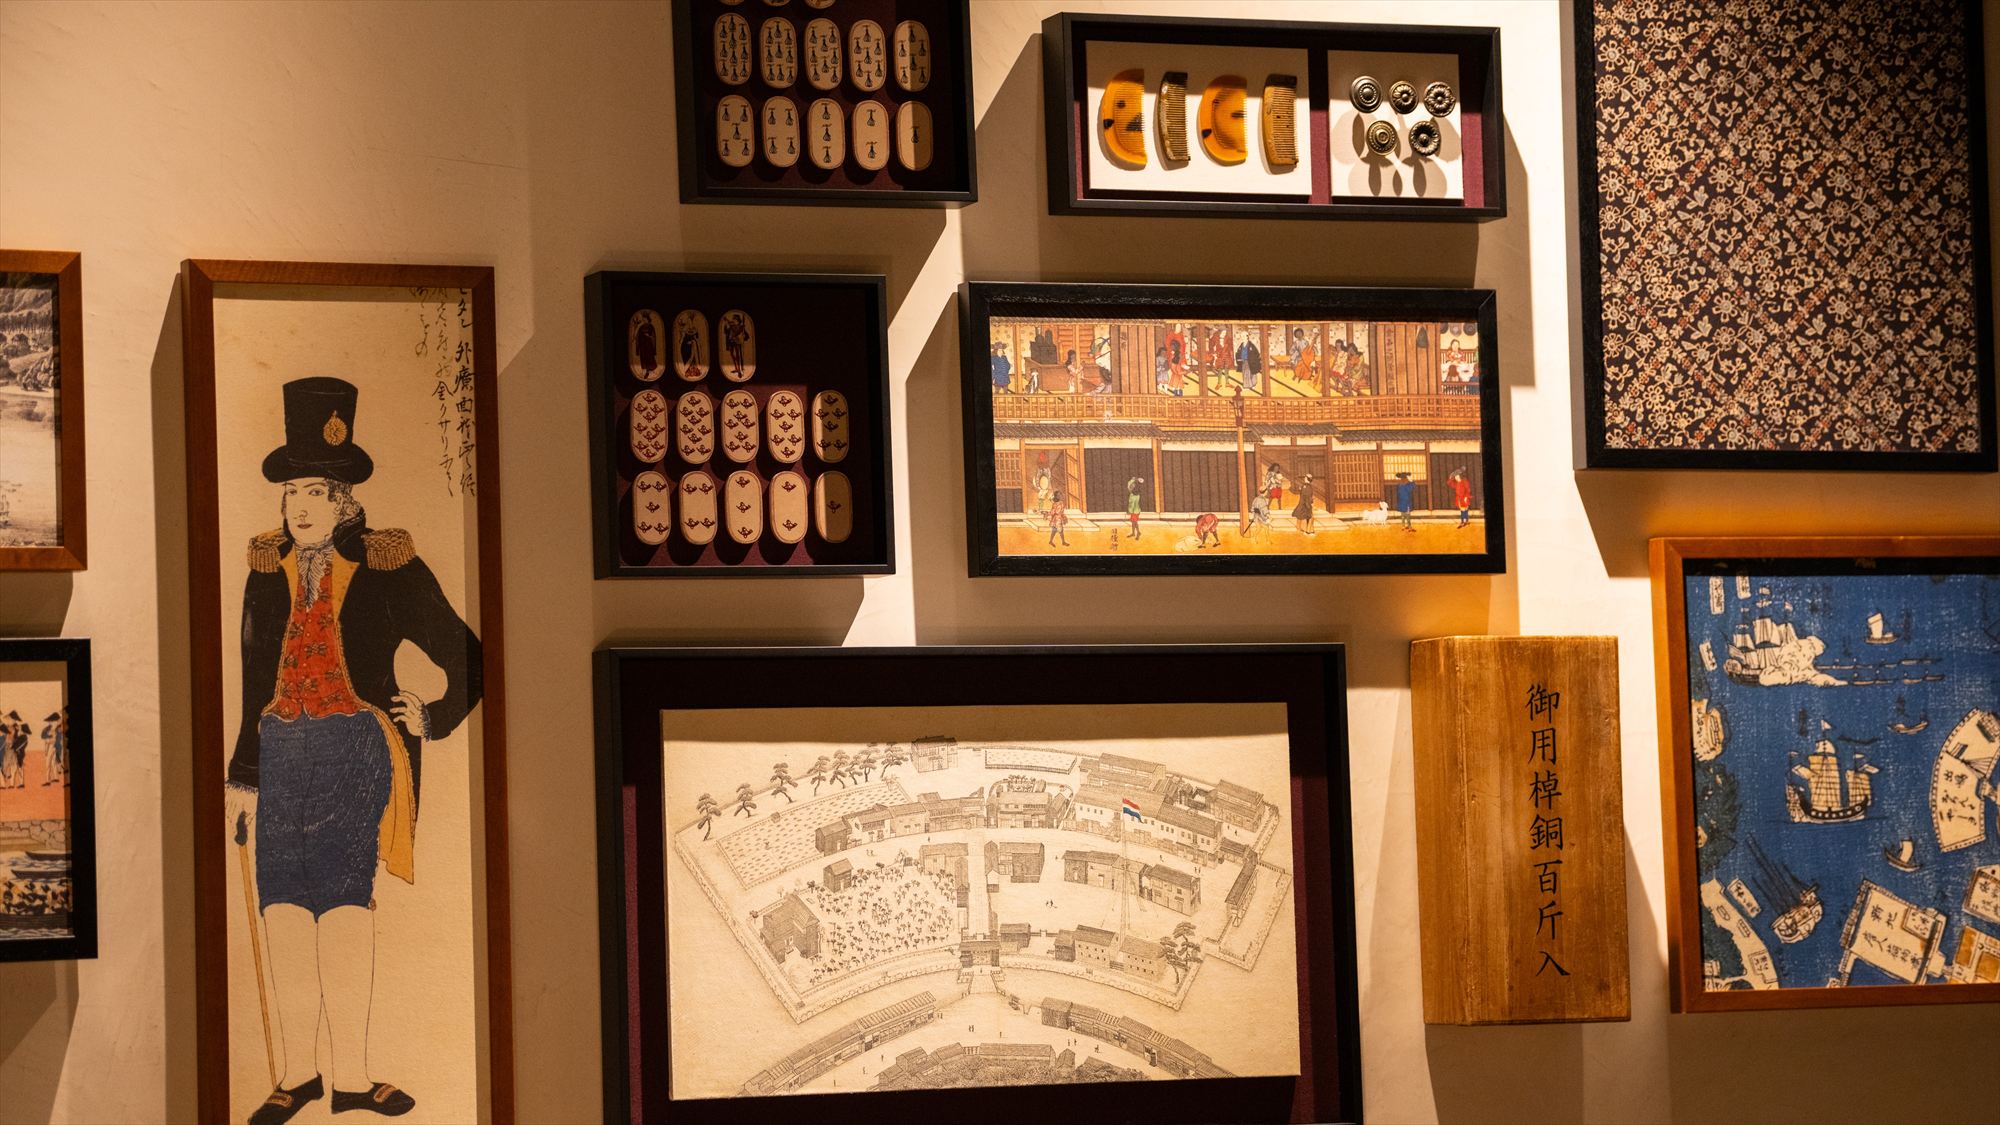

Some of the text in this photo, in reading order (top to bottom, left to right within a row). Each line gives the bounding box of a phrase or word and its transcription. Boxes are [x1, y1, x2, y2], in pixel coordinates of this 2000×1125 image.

[1525, 684, 1570, 977] 御用棹銅百斤入
